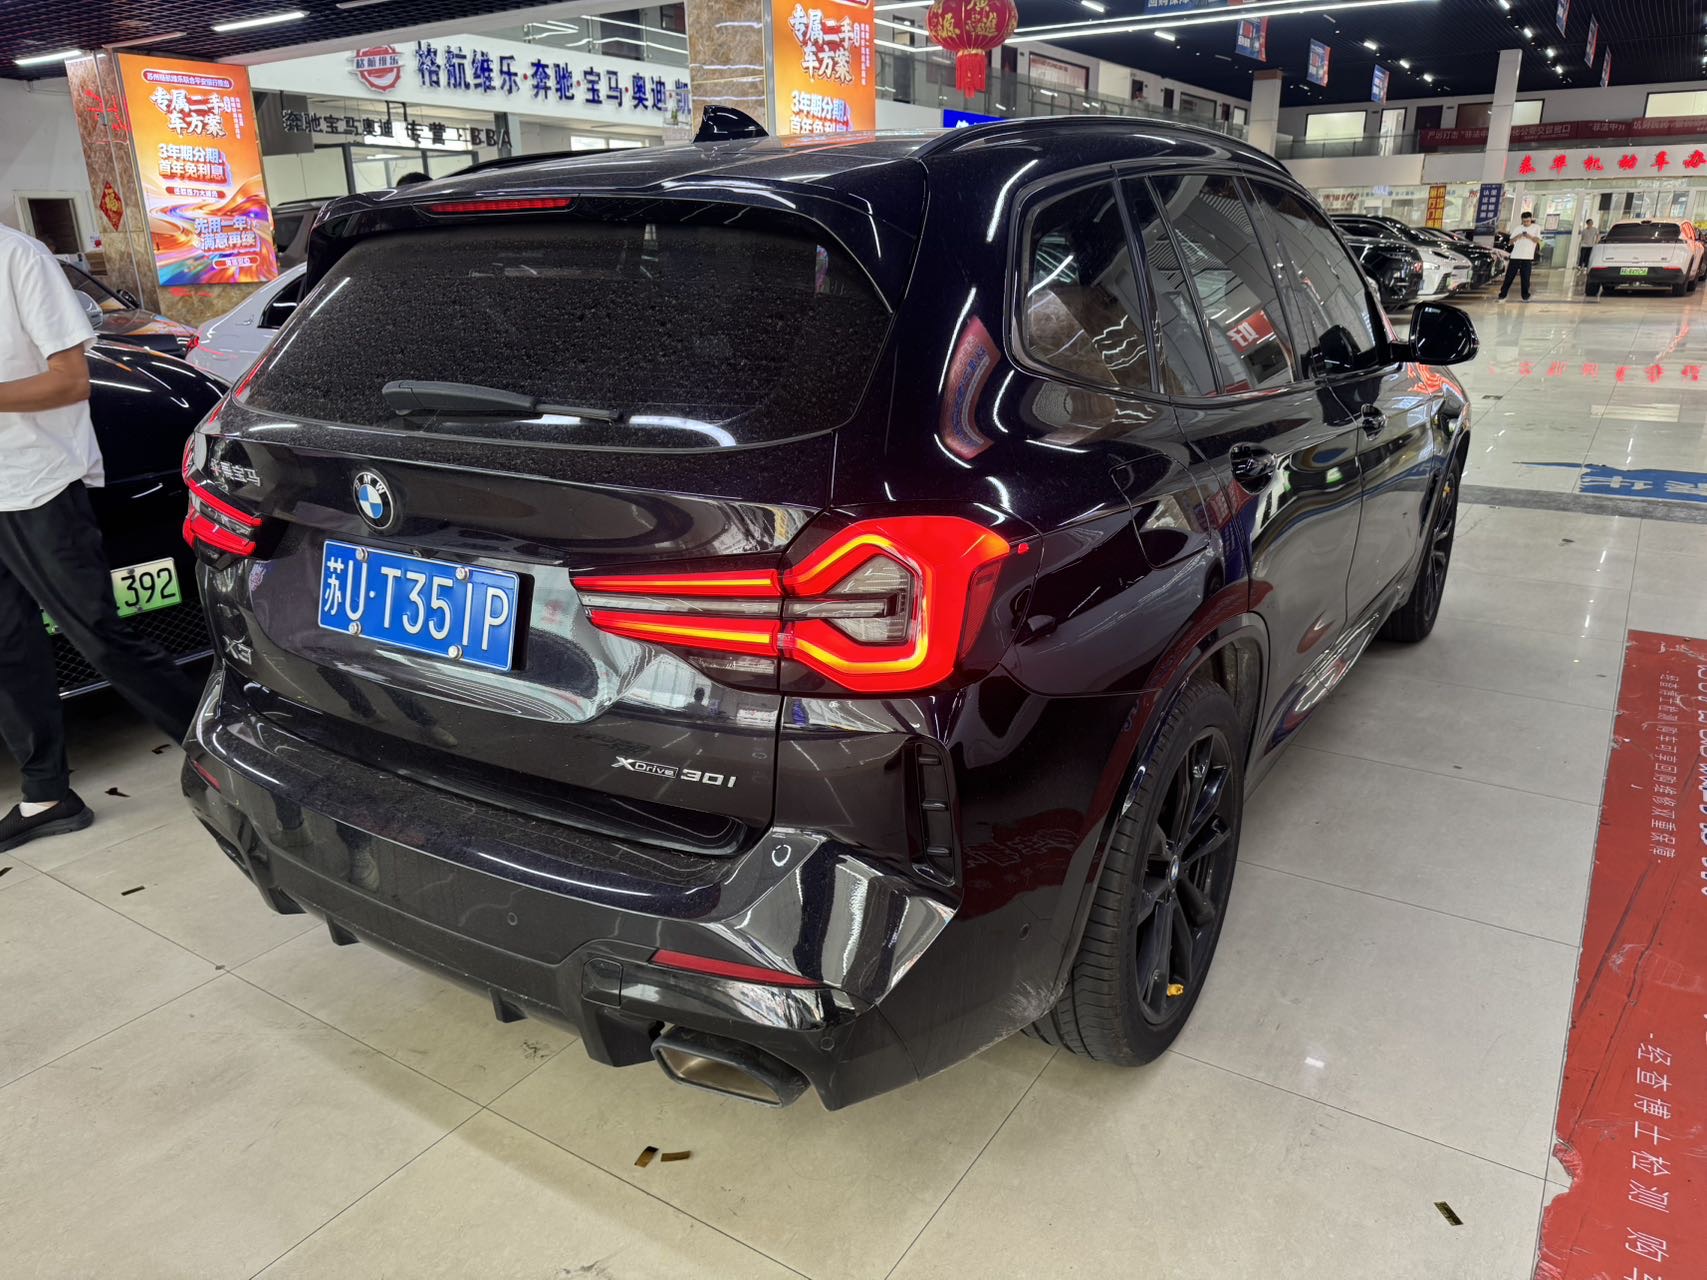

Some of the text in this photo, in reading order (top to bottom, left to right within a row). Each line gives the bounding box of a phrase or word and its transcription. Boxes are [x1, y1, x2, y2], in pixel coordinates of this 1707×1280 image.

[788, 4, 854, 48] 专属二手
[801, 40, 853, 84] 车方案
[150, 87, 224, 114] 专属二手
[168, 111, 227, 137] 车方案
[284, 110, 394, 138] 奔驰宝马奥迪
[470, 127, 512, 148] BBA
[160, 159, 226, 179] 首年免利息
[222, 635, 253, 665] X3
